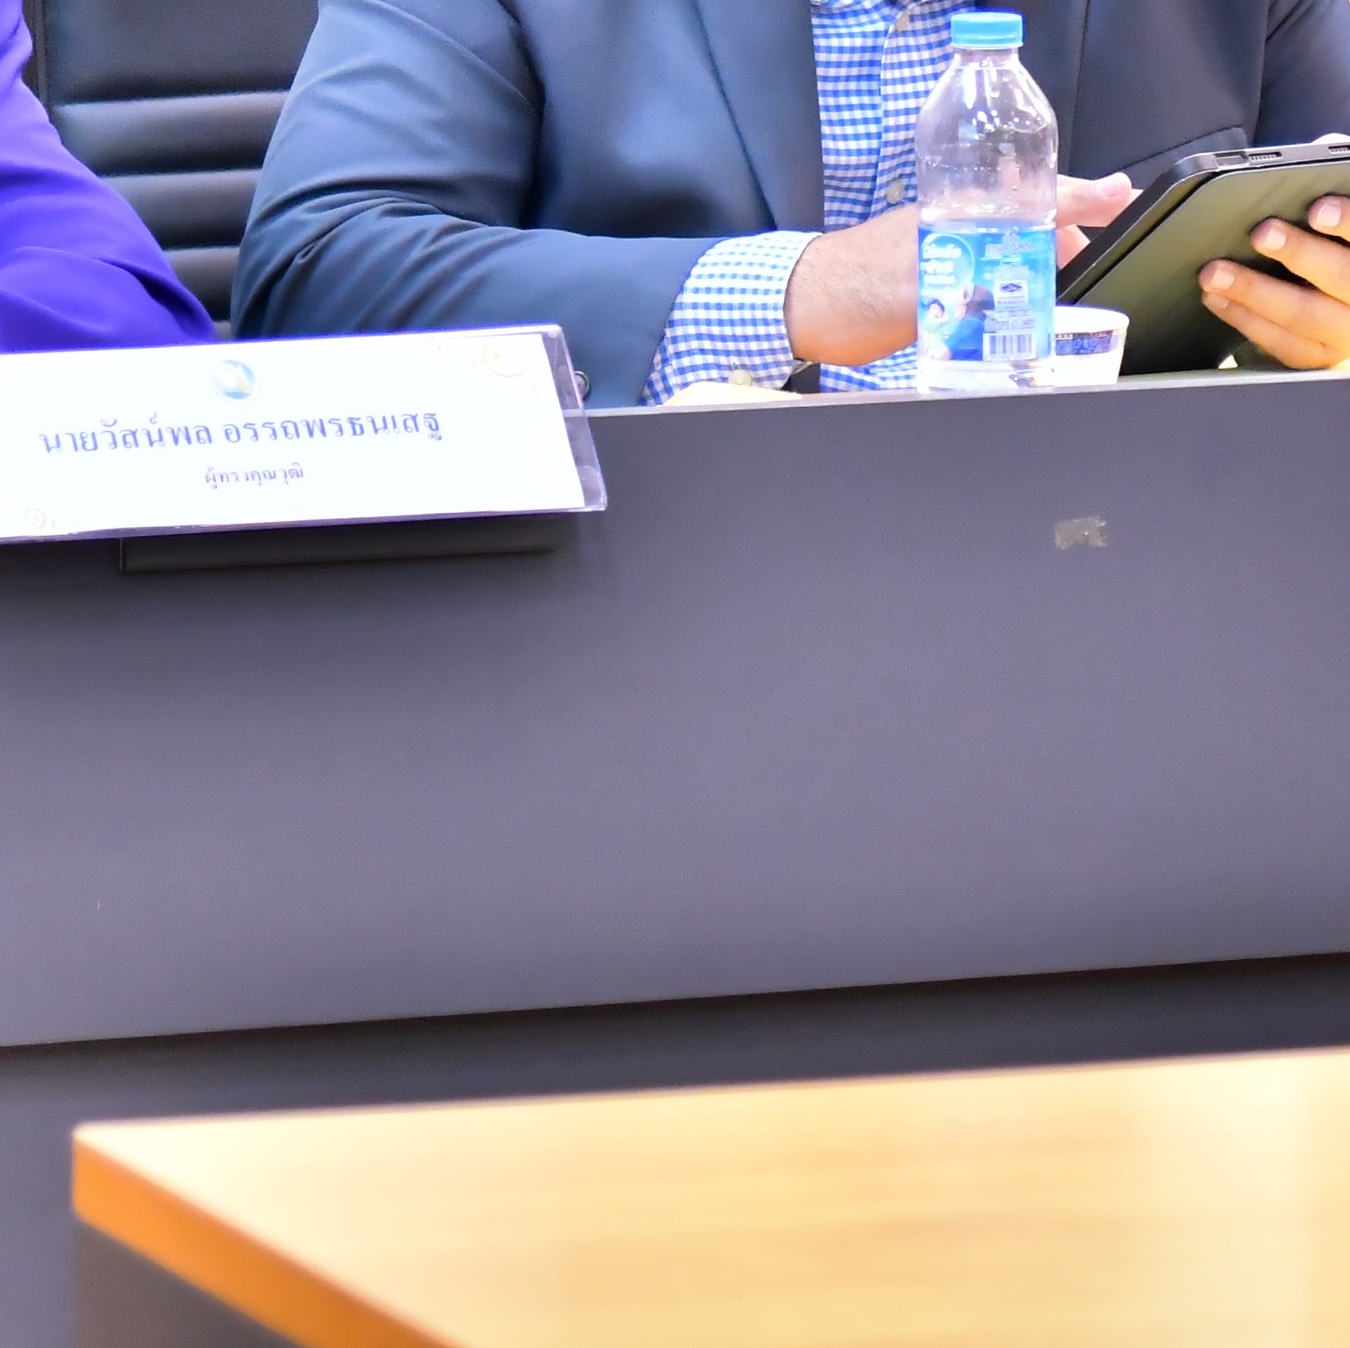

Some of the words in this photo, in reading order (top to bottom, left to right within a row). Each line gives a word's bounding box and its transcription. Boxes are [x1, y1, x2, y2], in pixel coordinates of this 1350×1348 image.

[38, 411, 213, 454] นายวัสน์พล
[204, 461, 305, 490] ผู้ทรงคุณวุฒิ
